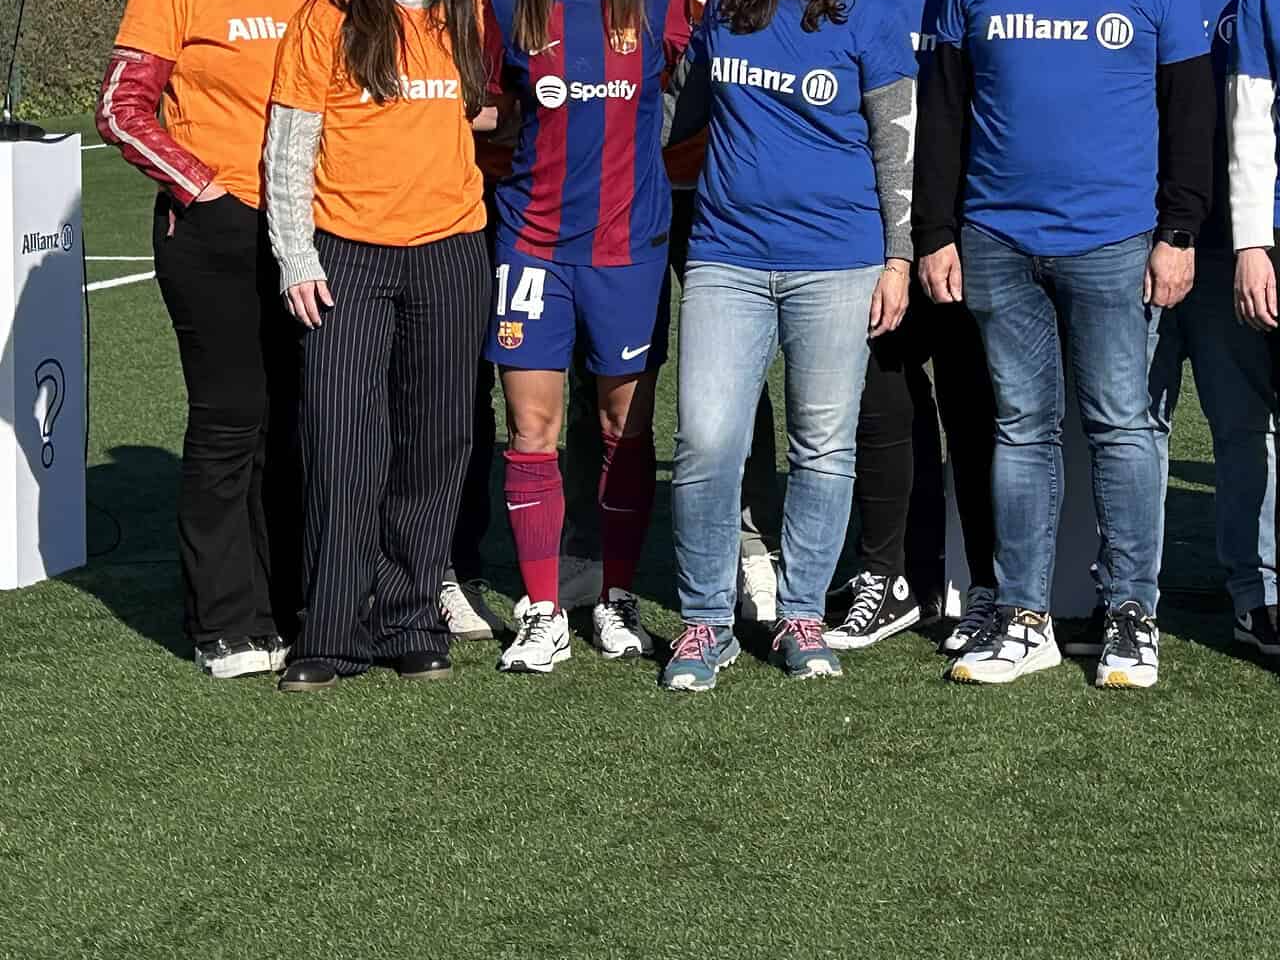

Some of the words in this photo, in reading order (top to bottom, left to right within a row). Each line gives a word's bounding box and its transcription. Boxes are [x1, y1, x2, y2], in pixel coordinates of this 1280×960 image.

[987, 13, 1088, 41] Allianz
[711, 57, 796, 95] Allianz
[570, 80, 637, 102] Spotify
[22, 233, 59, 254] Allianz
[496, 264, 546, 320] 14
